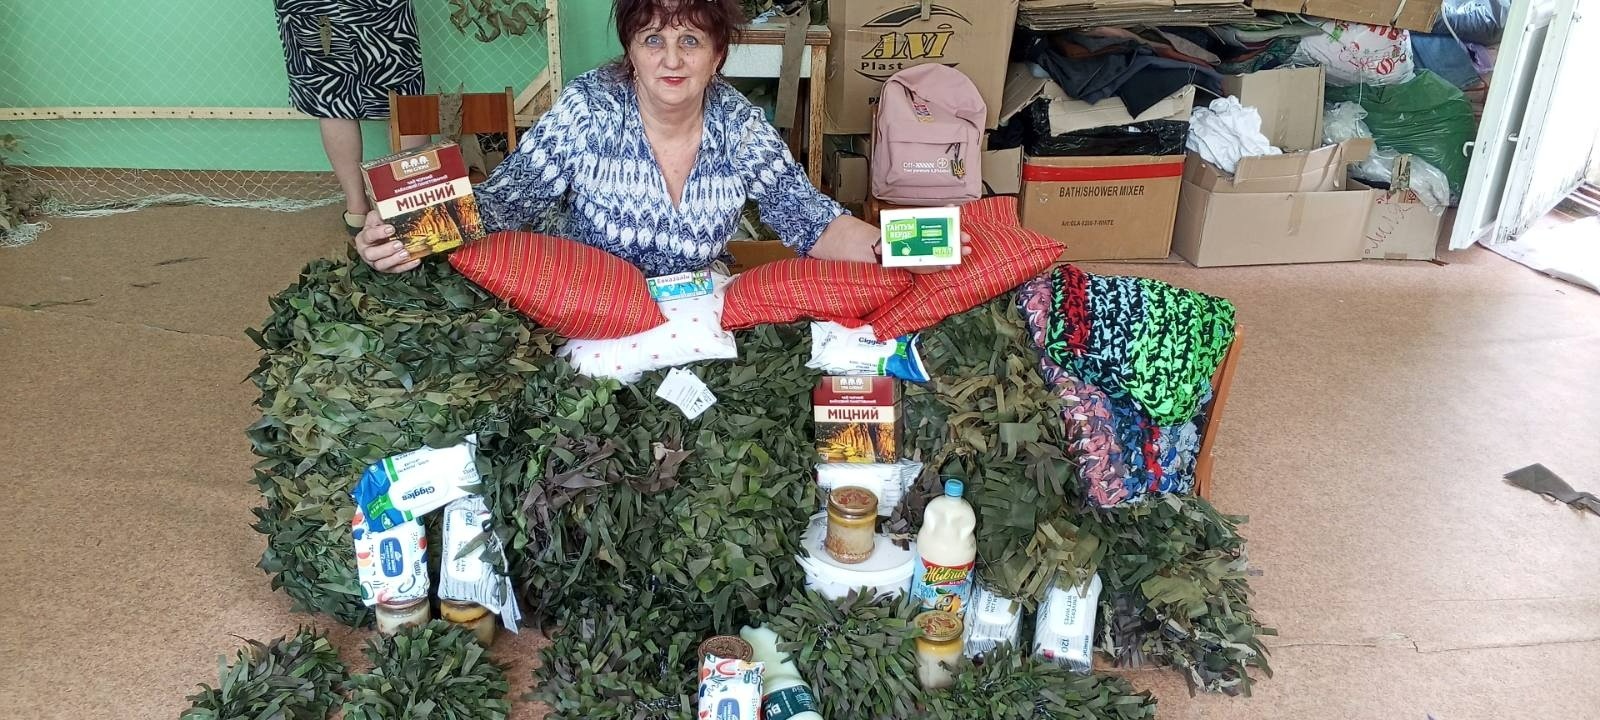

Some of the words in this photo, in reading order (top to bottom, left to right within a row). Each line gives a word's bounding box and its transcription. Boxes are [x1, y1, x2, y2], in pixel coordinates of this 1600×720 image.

[861, 61, 904, 71] Plast
[396, 182, 456, 212] МІЦНИЙ
[1059, 186, 1118, 199] BATH/SHOWER
[1119, 185, 1145, 197] MIXER
[886, 223, 914, 232] ТАНТУМ
[828, 406, 879, 421] МІЦНИЙ
[401, 486, 436, 502] Giggles
[1061, 639, 1070, 654] 120
